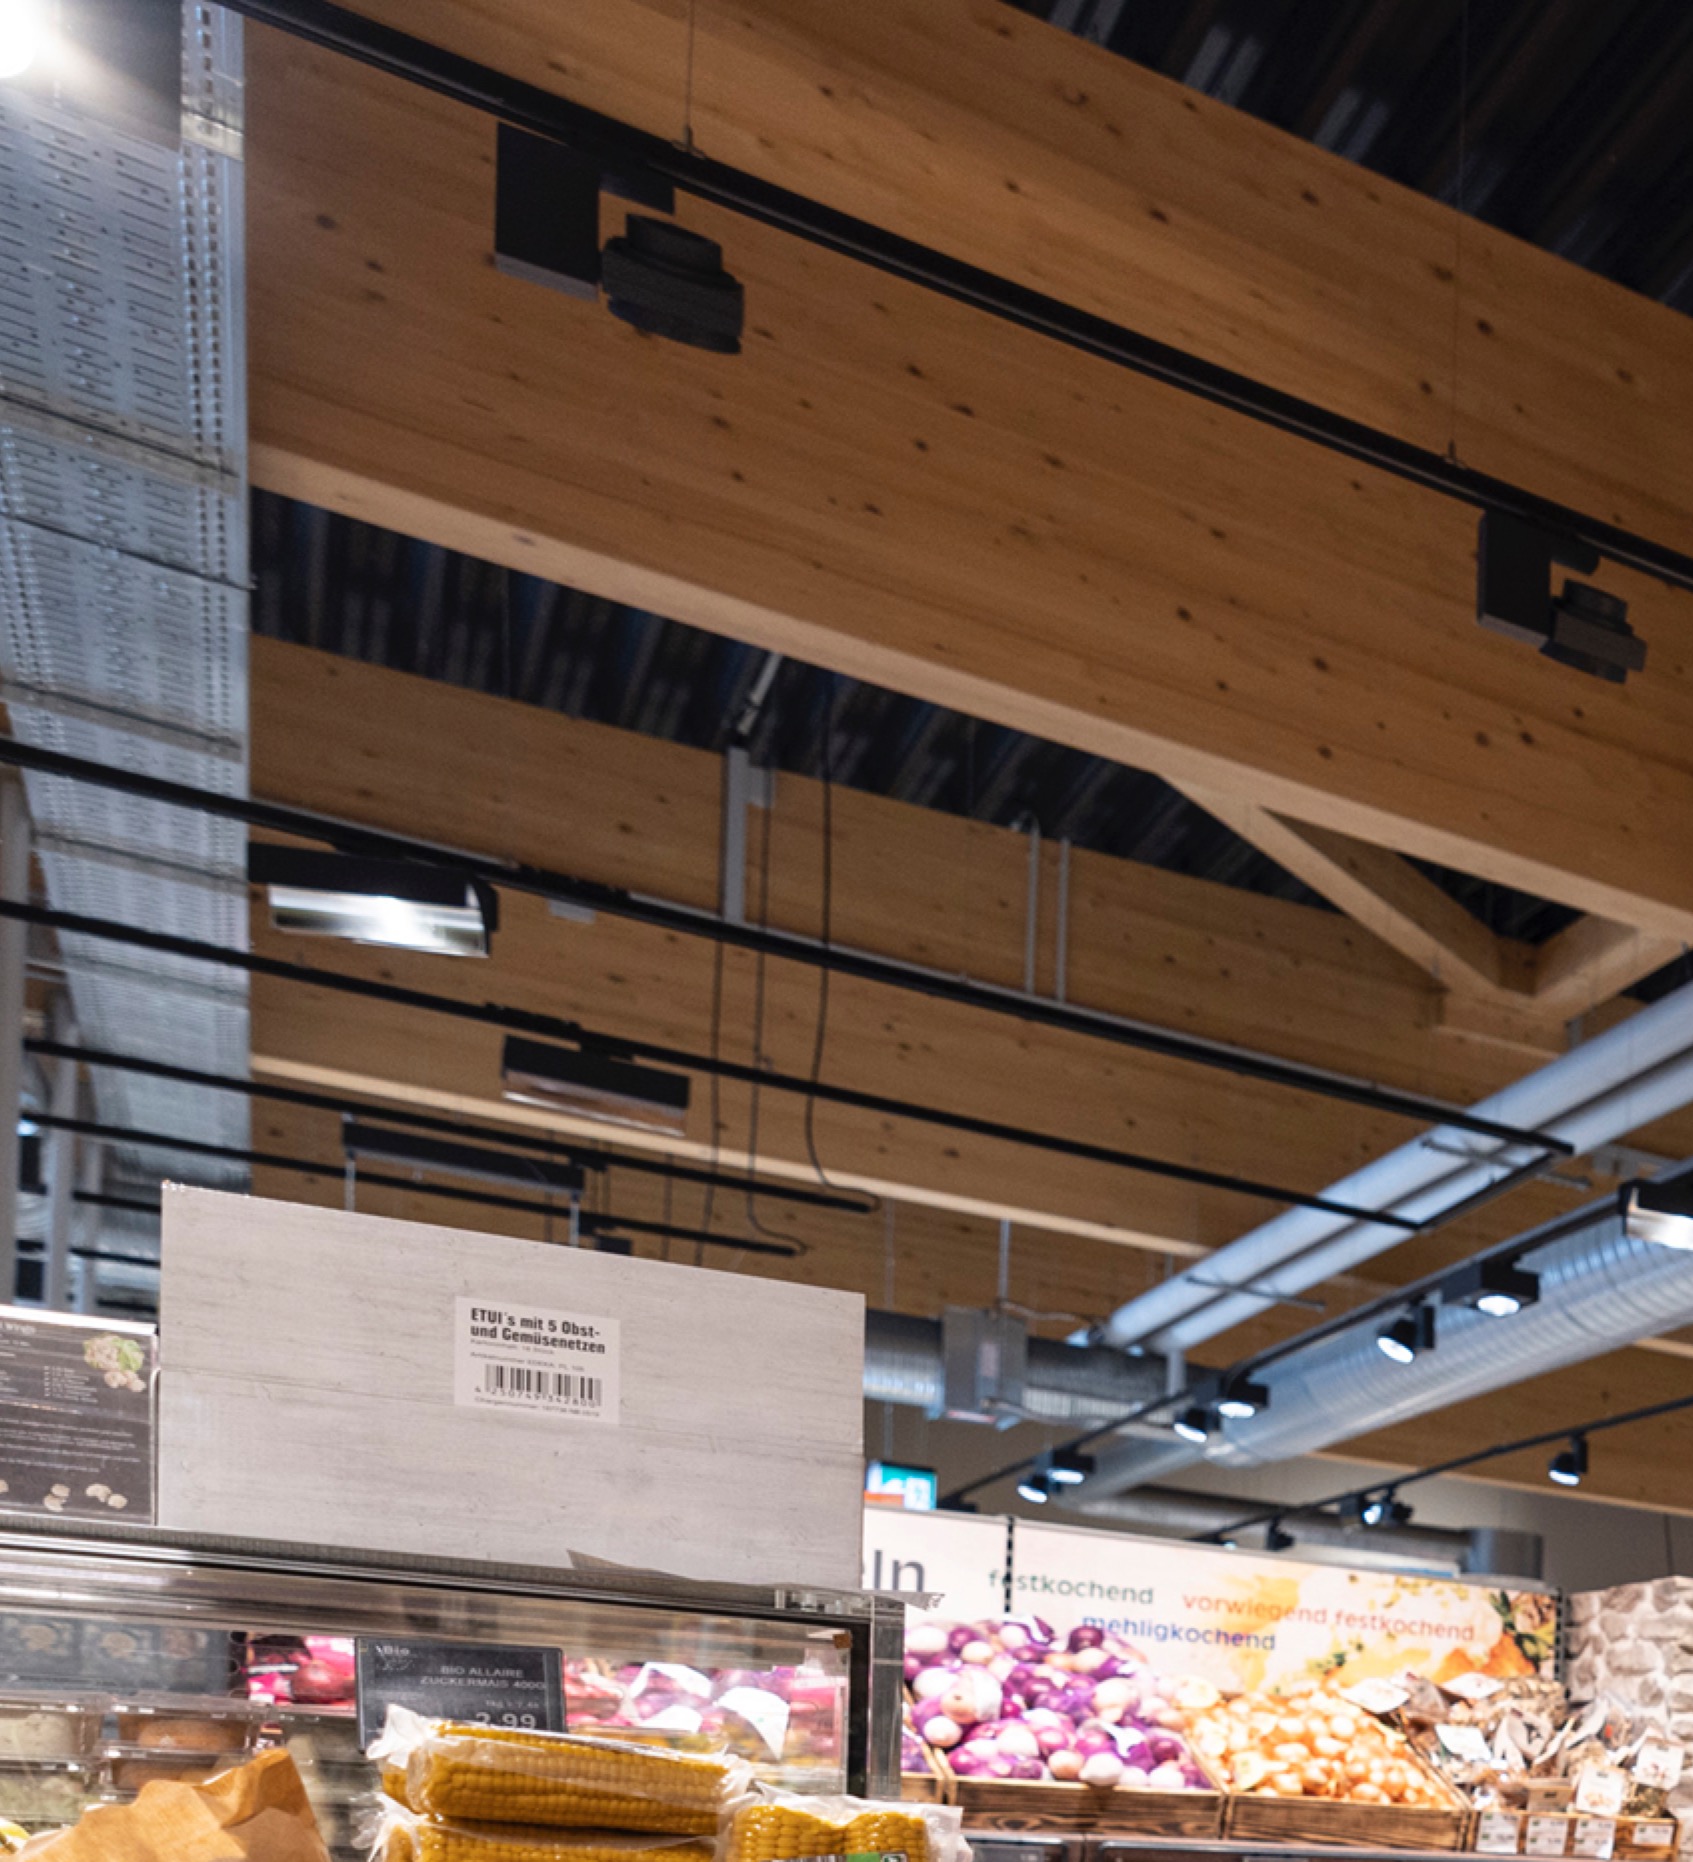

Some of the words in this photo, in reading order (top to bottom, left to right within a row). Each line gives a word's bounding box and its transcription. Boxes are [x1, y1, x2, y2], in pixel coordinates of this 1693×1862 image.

[470, 1325, 498, 1339] und
[502, 1327, 606, 1354] Gemüsenetzen
[520, 1316, 544, 1331] mit
[548, 1319, 558, 1333] 5
[561, 1321, 600, 1338] Obst-
[864, 1549, 926, 1592] ln
[1183, 1592, 1328, 1626] vorwiegend
[1335, 1608, 1476, 1642] festkochend
[1081, 1613, 1276, 1652] mehligkochend
[420, 1675, 510, 1690] ZUCKERMAIS
[469, 1667, 525, 1679] ALLAIRE
[475, 1711, 537, 1729] 299
